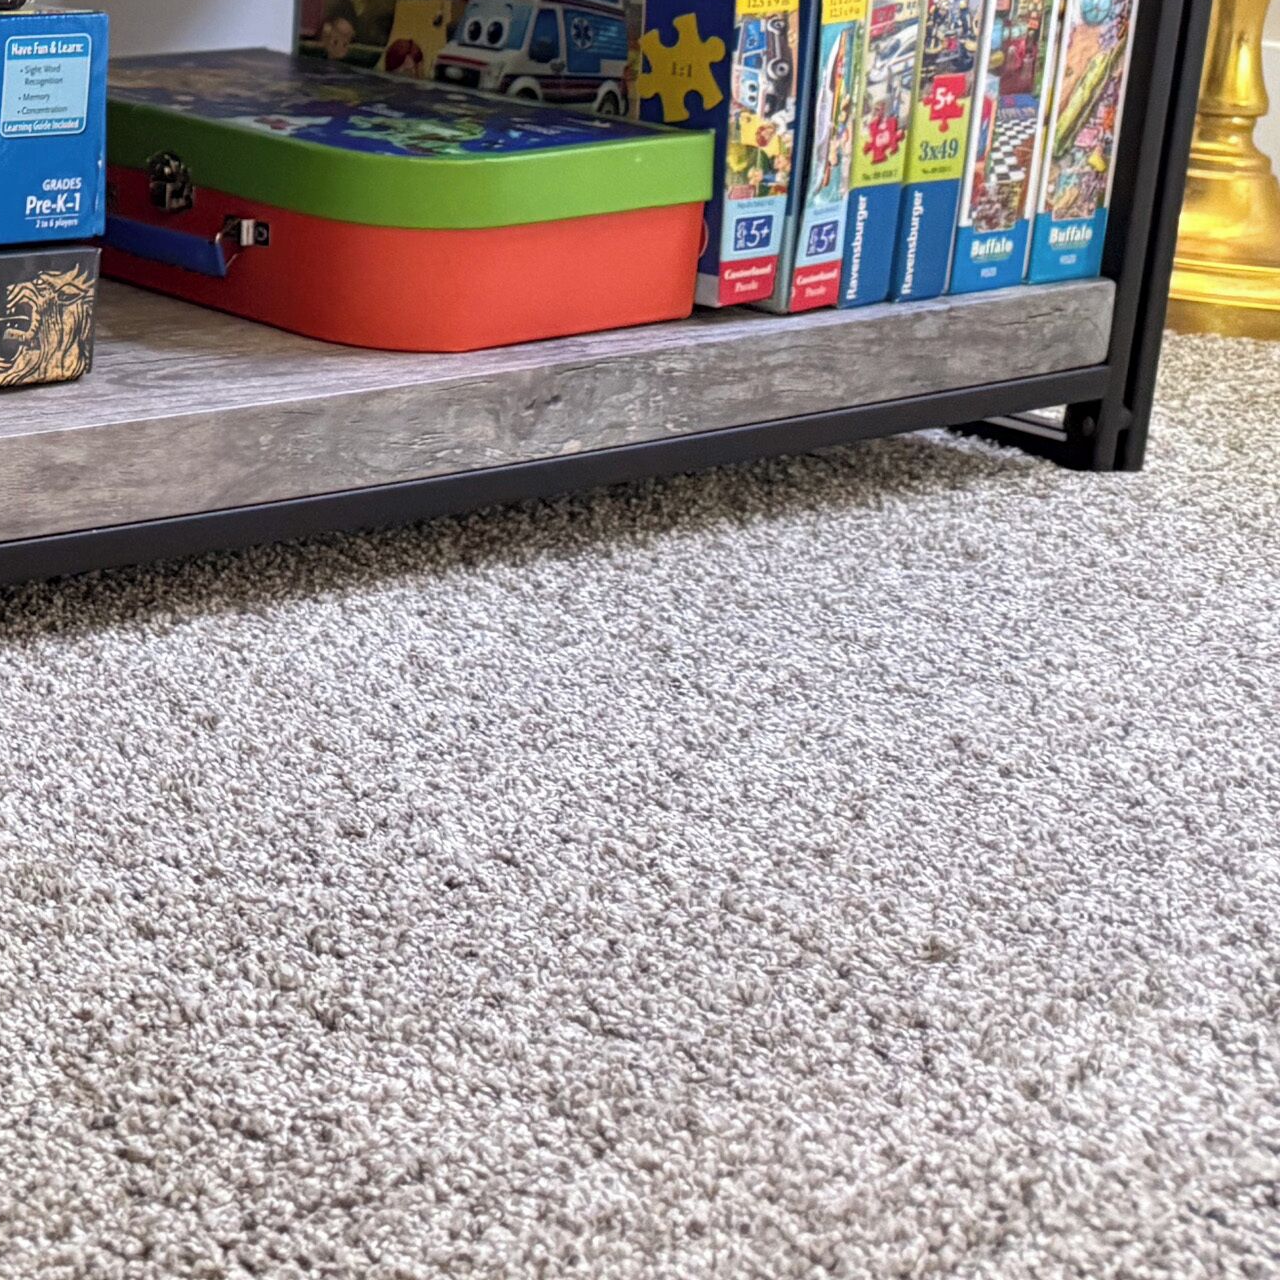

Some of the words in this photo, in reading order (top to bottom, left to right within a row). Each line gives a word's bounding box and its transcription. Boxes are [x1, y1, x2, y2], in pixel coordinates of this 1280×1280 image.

[11, 42, 33, 56] Have
[33, 41, 48, 55] Fun
[933, 88, 955, 110] 5+
[918, 138, 960, 161] 3x49
[42, 177, 82, 191] GRADES
[25, 192, 81, 215] Pre-K-1
[746, 218, 770, 247] 5+
[817, 224, 836, 253] 5+
[901, 190, 923, 296] Ravensburger
[1049, 224, 1094, 245] Buffalo
[846, 195, 868, 301] Ravensburger
[970, 236, 1014, 259] Buffalo
